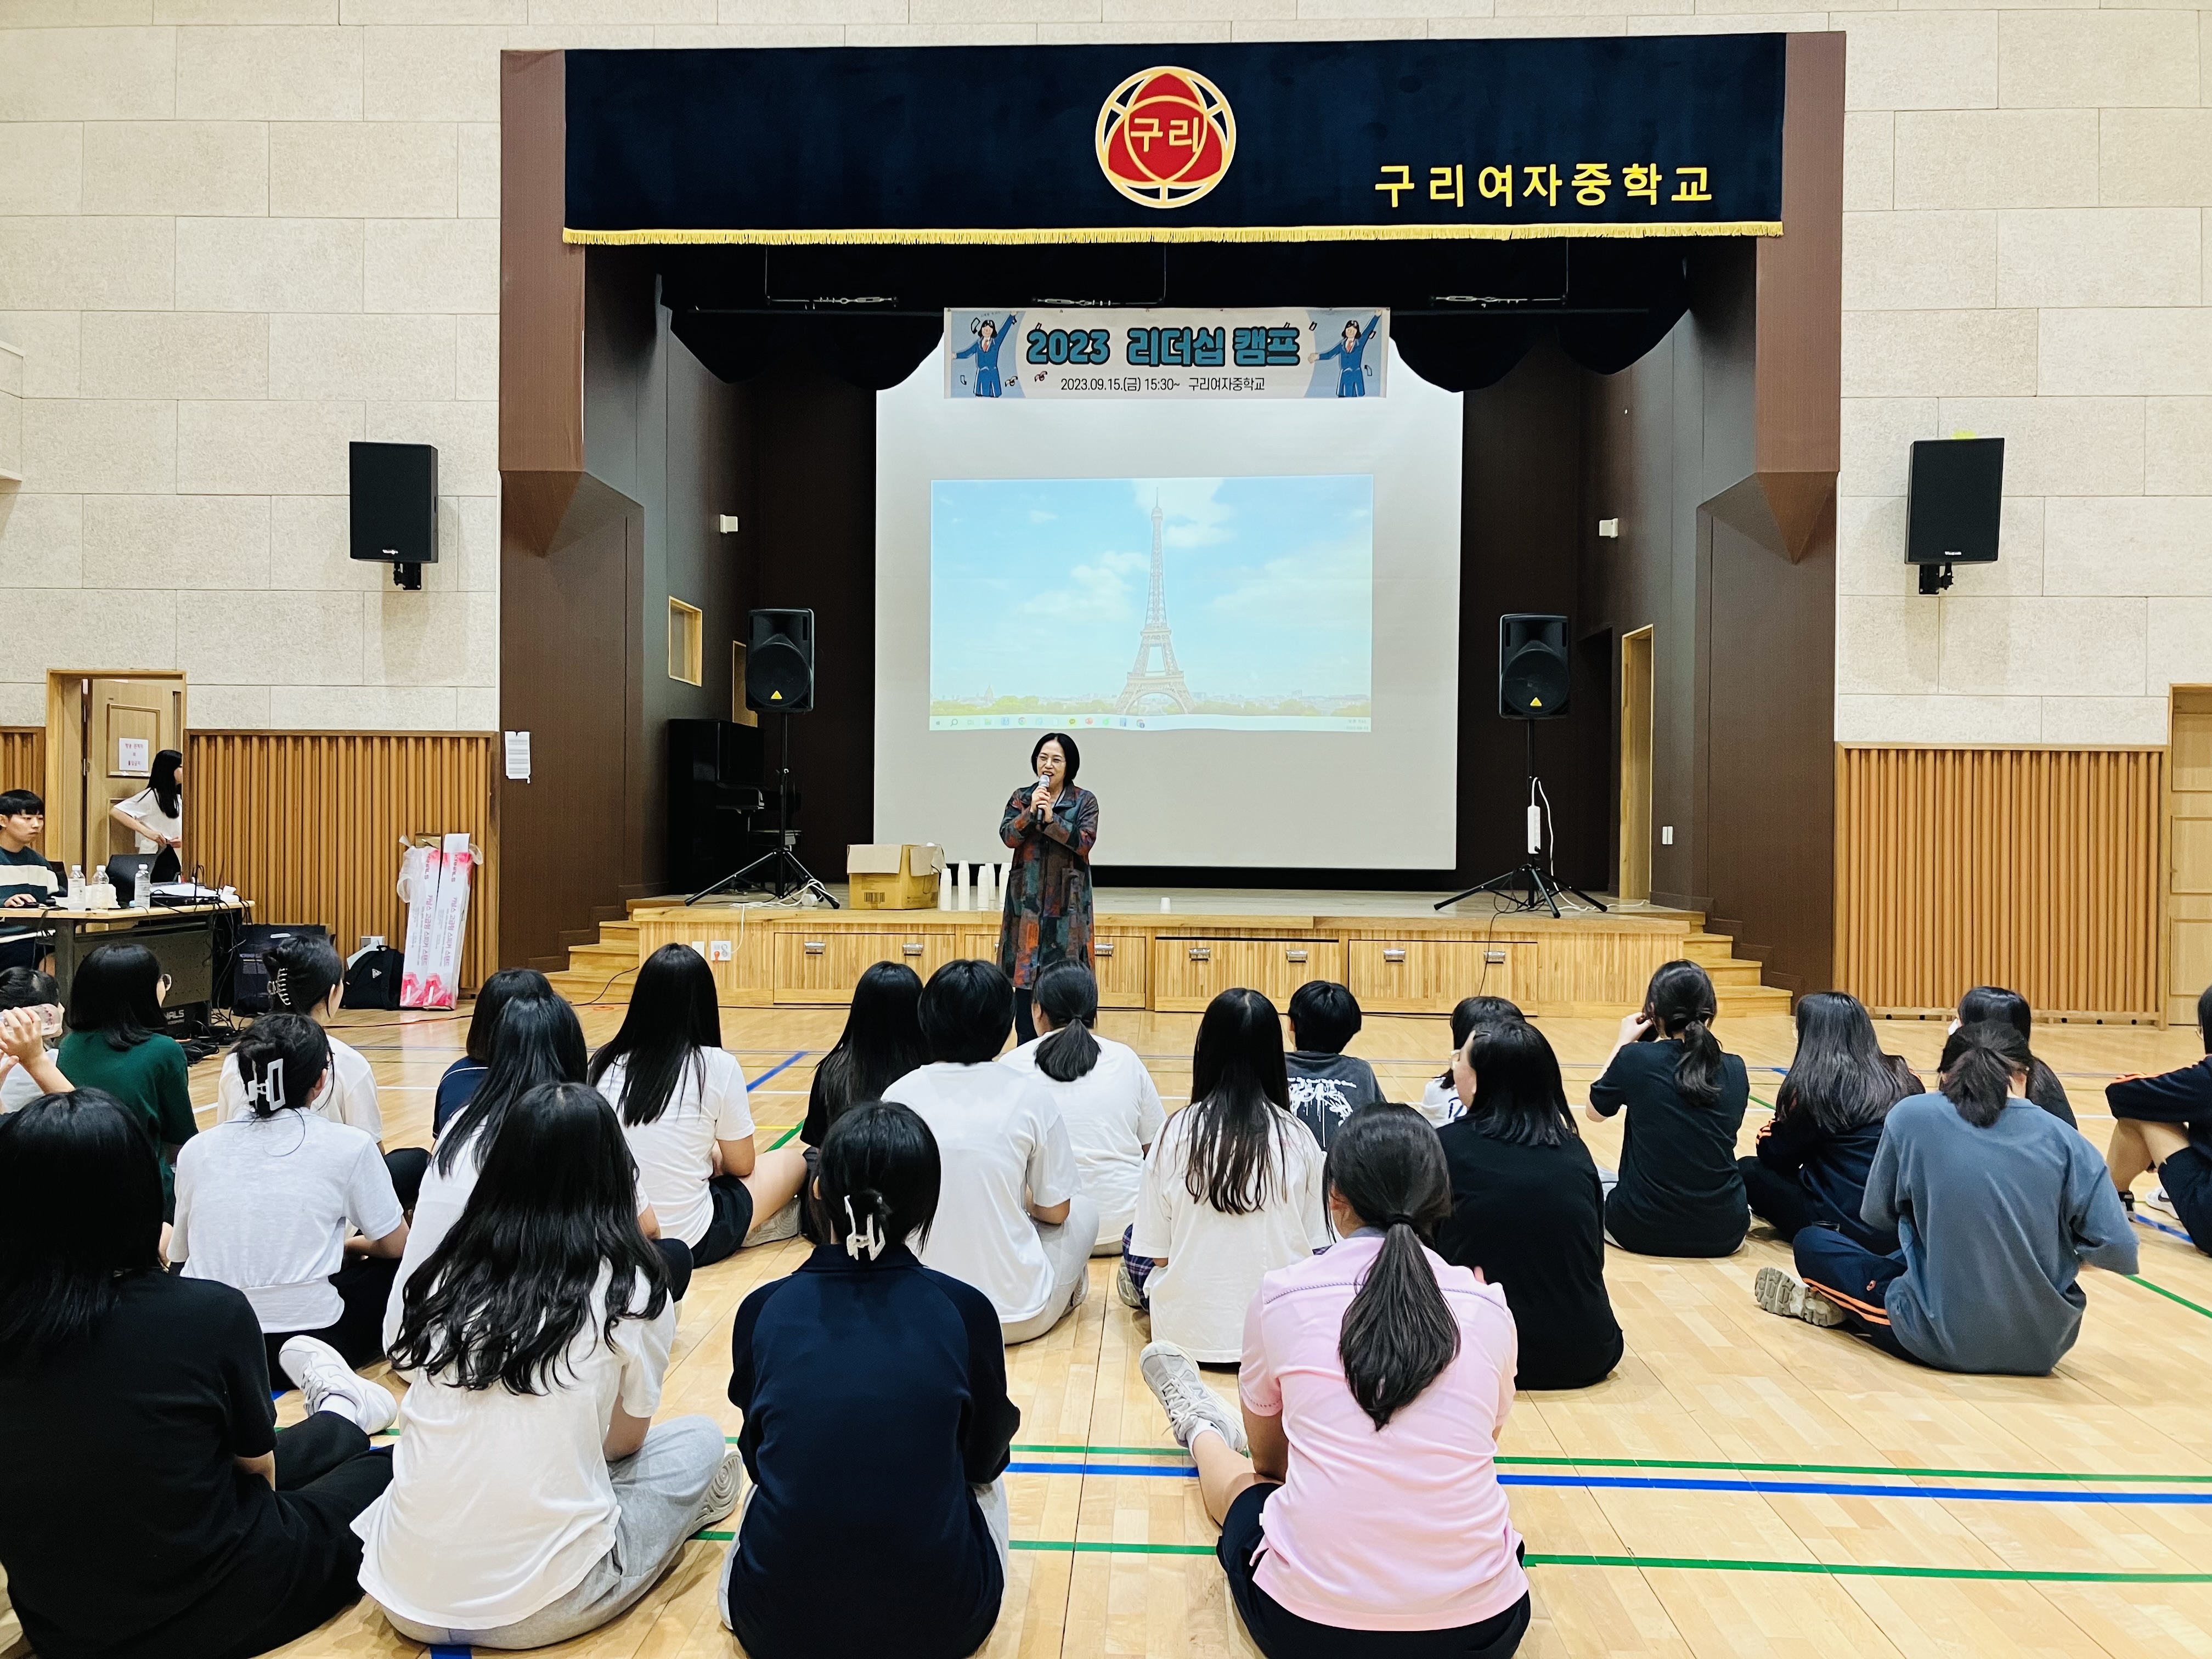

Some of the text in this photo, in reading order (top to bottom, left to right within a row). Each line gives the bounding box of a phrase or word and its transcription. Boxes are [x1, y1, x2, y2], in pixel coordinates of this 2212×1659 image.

[1130, 117, 1199, 153] 구리
[1375, 163, 1712, 208] 구리여자중학교
[1026, 326, 1300, 367] 2023 리더십 캠프
[1060, 377, 1265, 391] 2023.09.15.(금) 15:30~ 구리여자중학교
[421, 949, 429, 966] 스탠드
